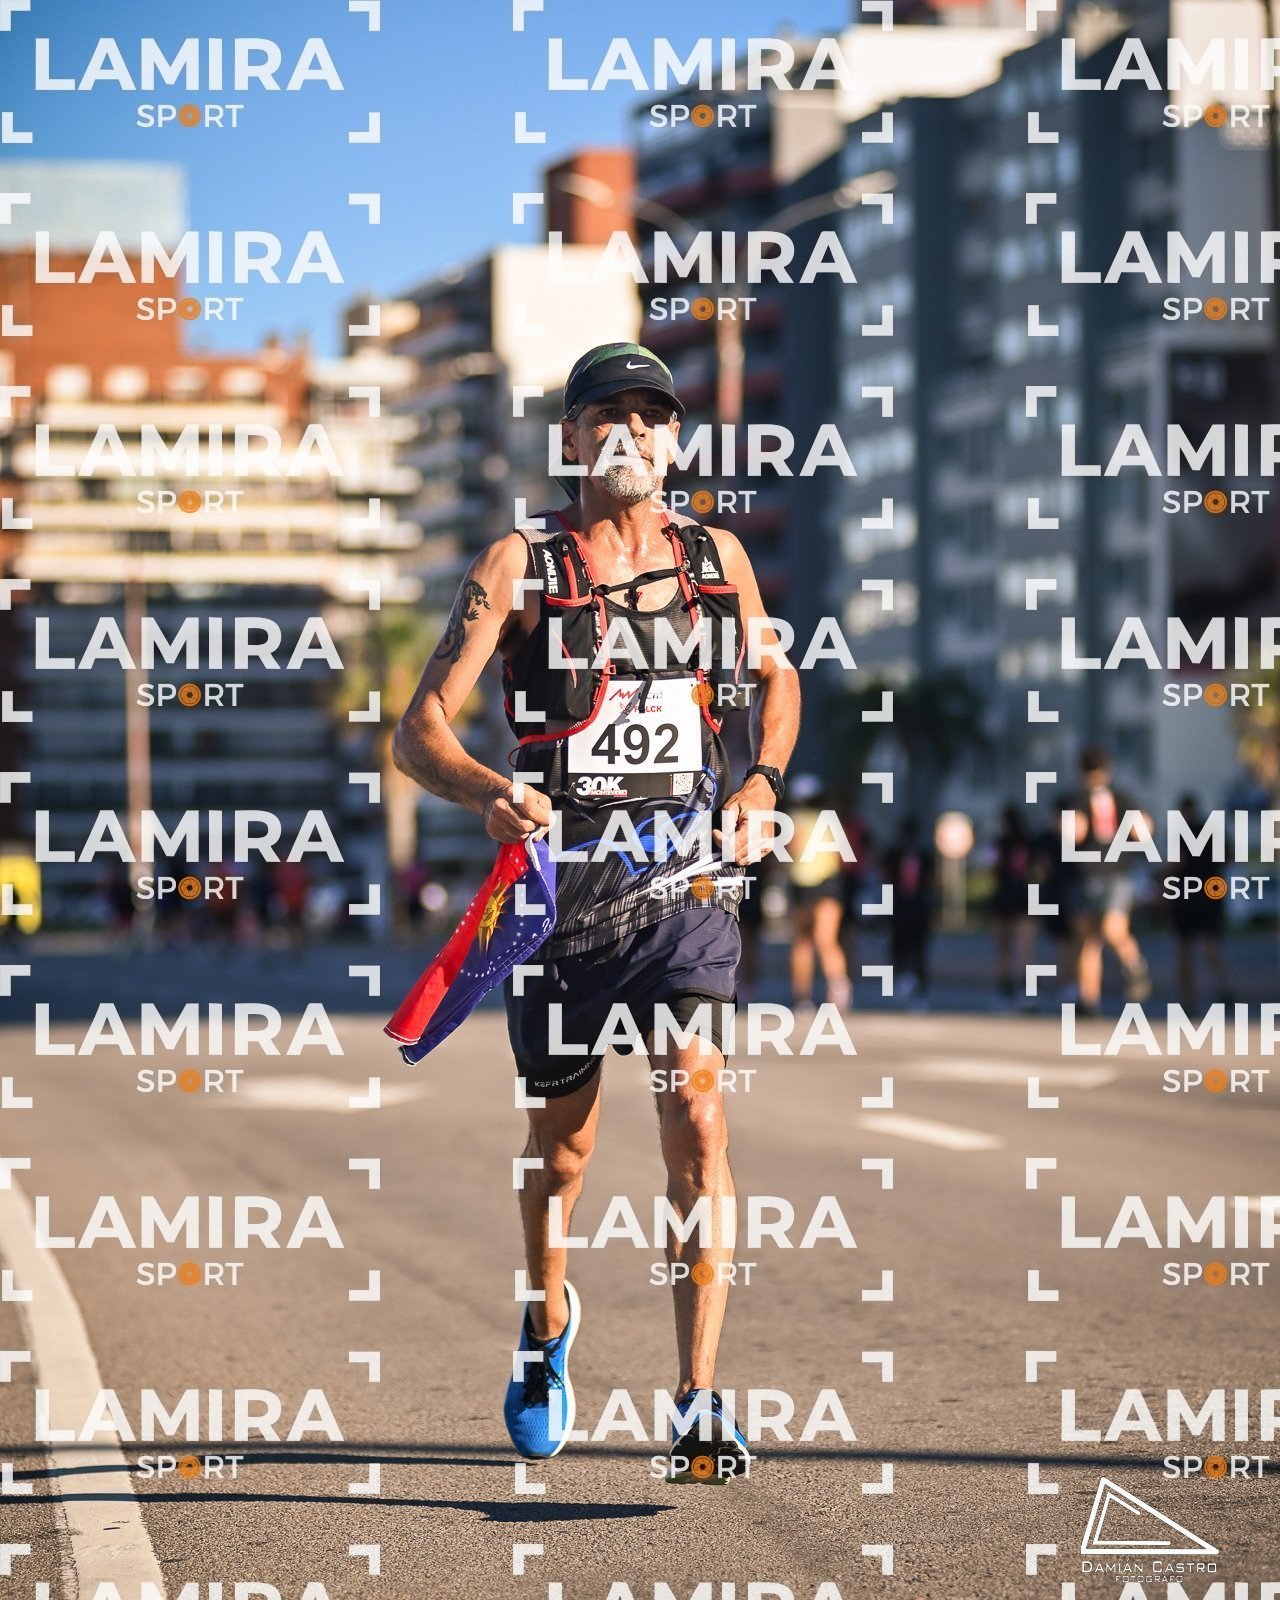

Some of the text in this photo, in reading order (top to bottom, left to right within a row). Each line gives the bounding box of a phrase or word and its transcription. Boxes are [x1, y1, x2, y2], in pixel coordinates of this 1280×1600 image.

[542, 548, 559, 595] AONIJIE
[634, 705, 662, 713] FLCK
[591, 723, 679, 765] 492
[575, 776, 624, 796] 30K
